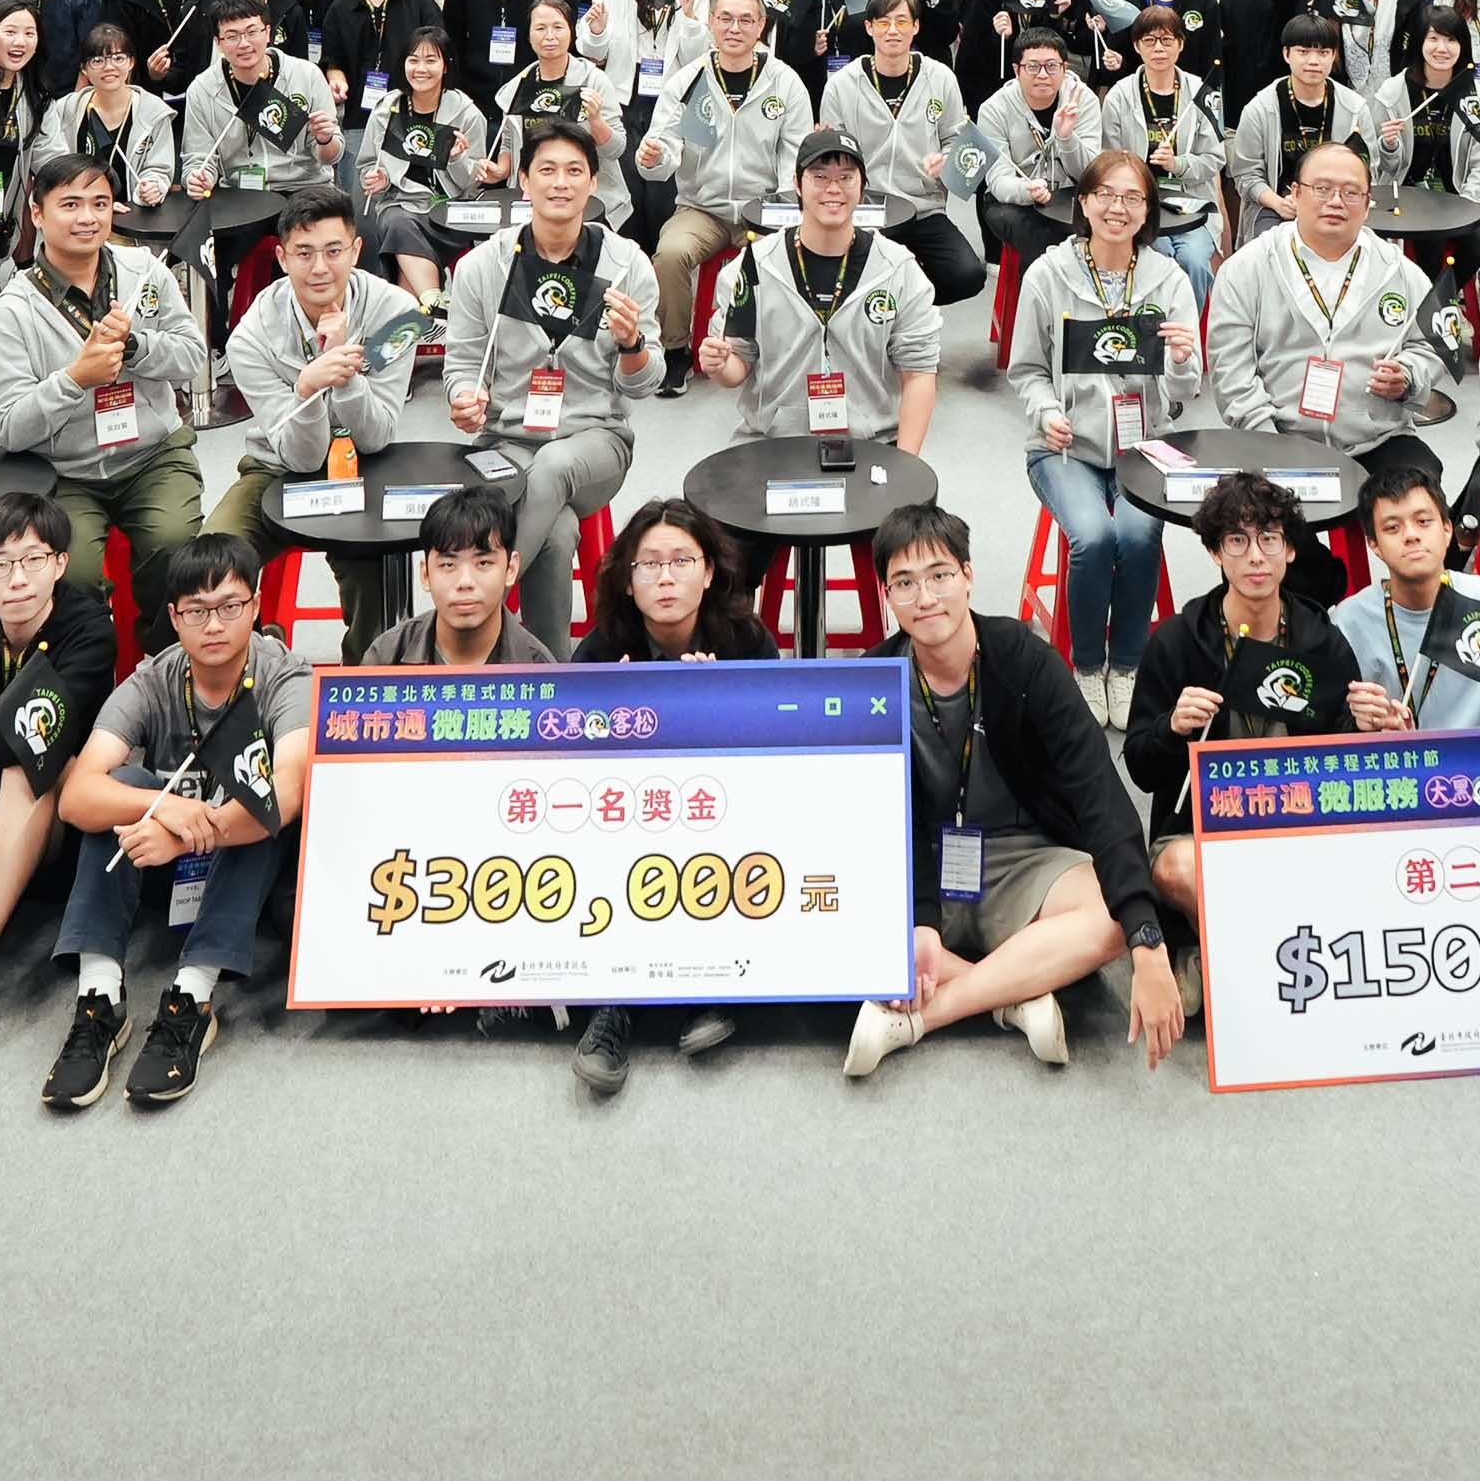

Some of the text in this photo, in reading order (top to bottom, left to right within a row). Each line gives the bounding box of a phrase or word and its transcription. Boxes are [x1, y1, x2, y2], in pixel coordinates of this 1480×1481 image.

[328, 682, 557, 704] 2025臺北秋季程式設計節
[1208, 749, 1440, 779] 2025臺北秋季程式設計節
[506, 786, 717, 824] 第一名獎金
[367, 848, 839, 937] $300,000 元
